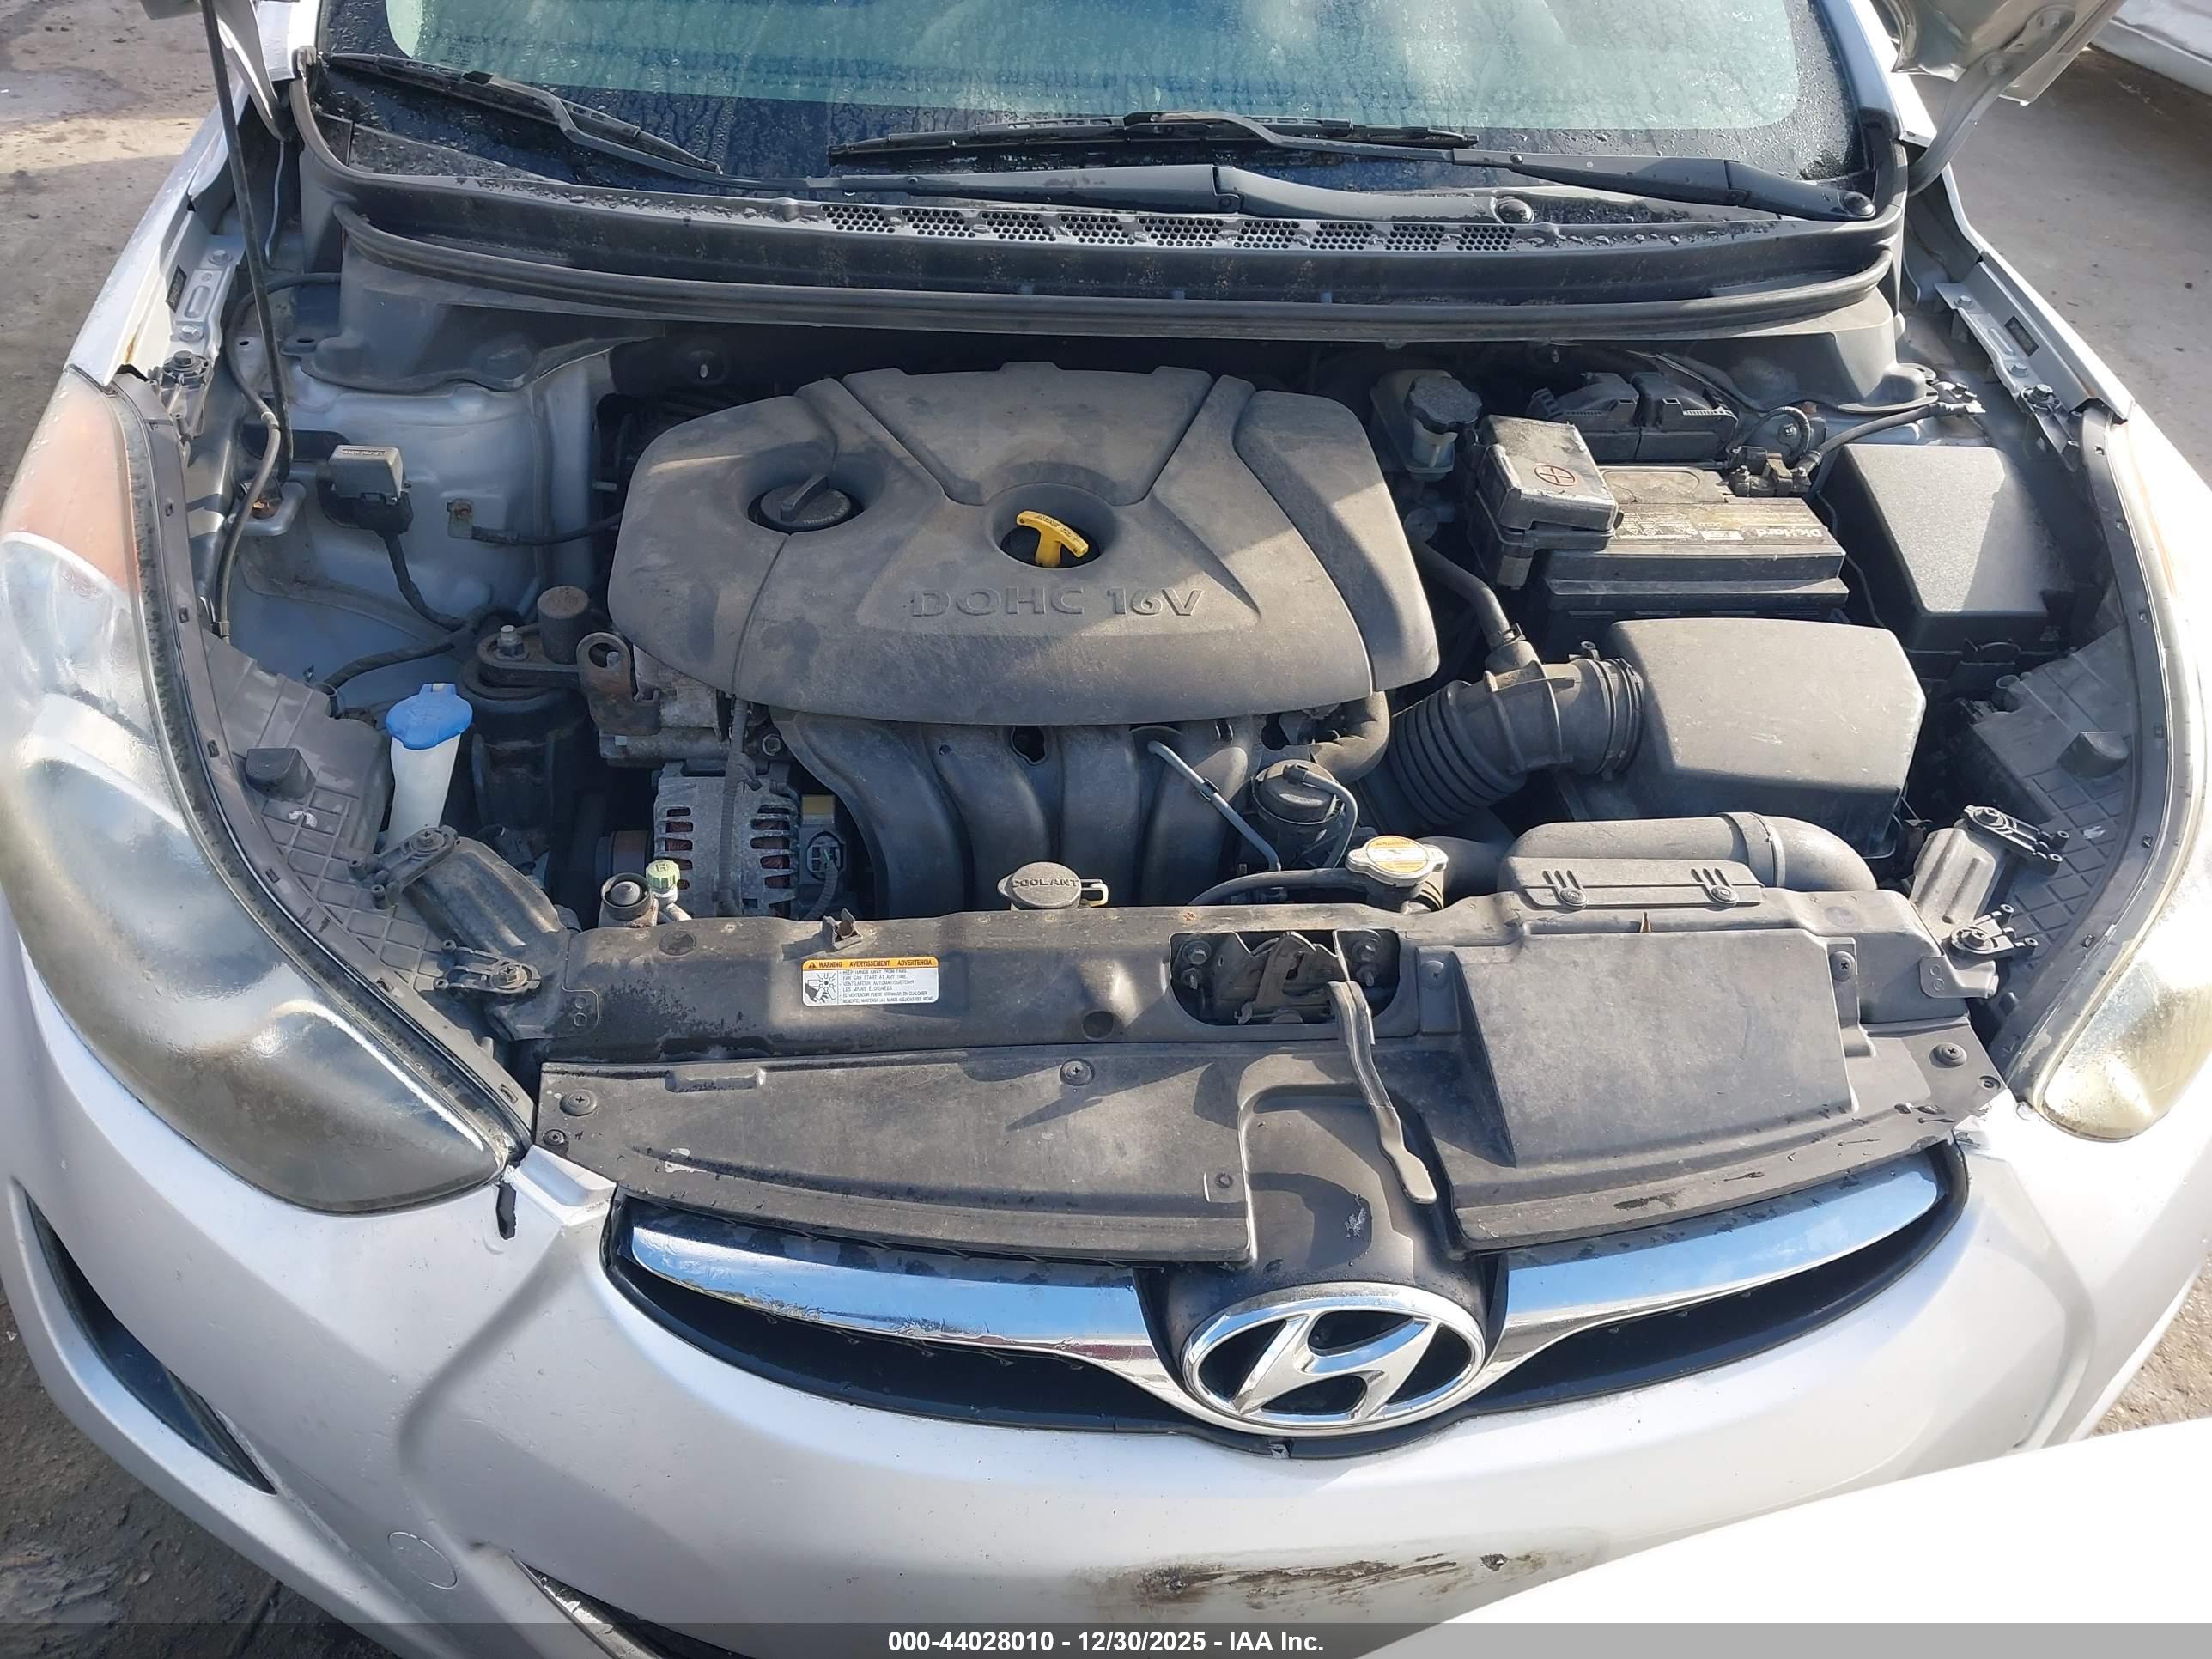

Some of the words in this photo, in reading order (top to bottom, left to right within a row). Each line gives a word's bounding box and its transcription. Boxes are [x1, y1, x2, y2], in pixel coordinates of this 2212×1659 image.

[1757, 528, 1823, 537] DieHard
[911, 586, 1083, 617] DOHC
[1106, 587, 1203, 617] 16V
[1012, 878, 1079, 888] COOLANT
